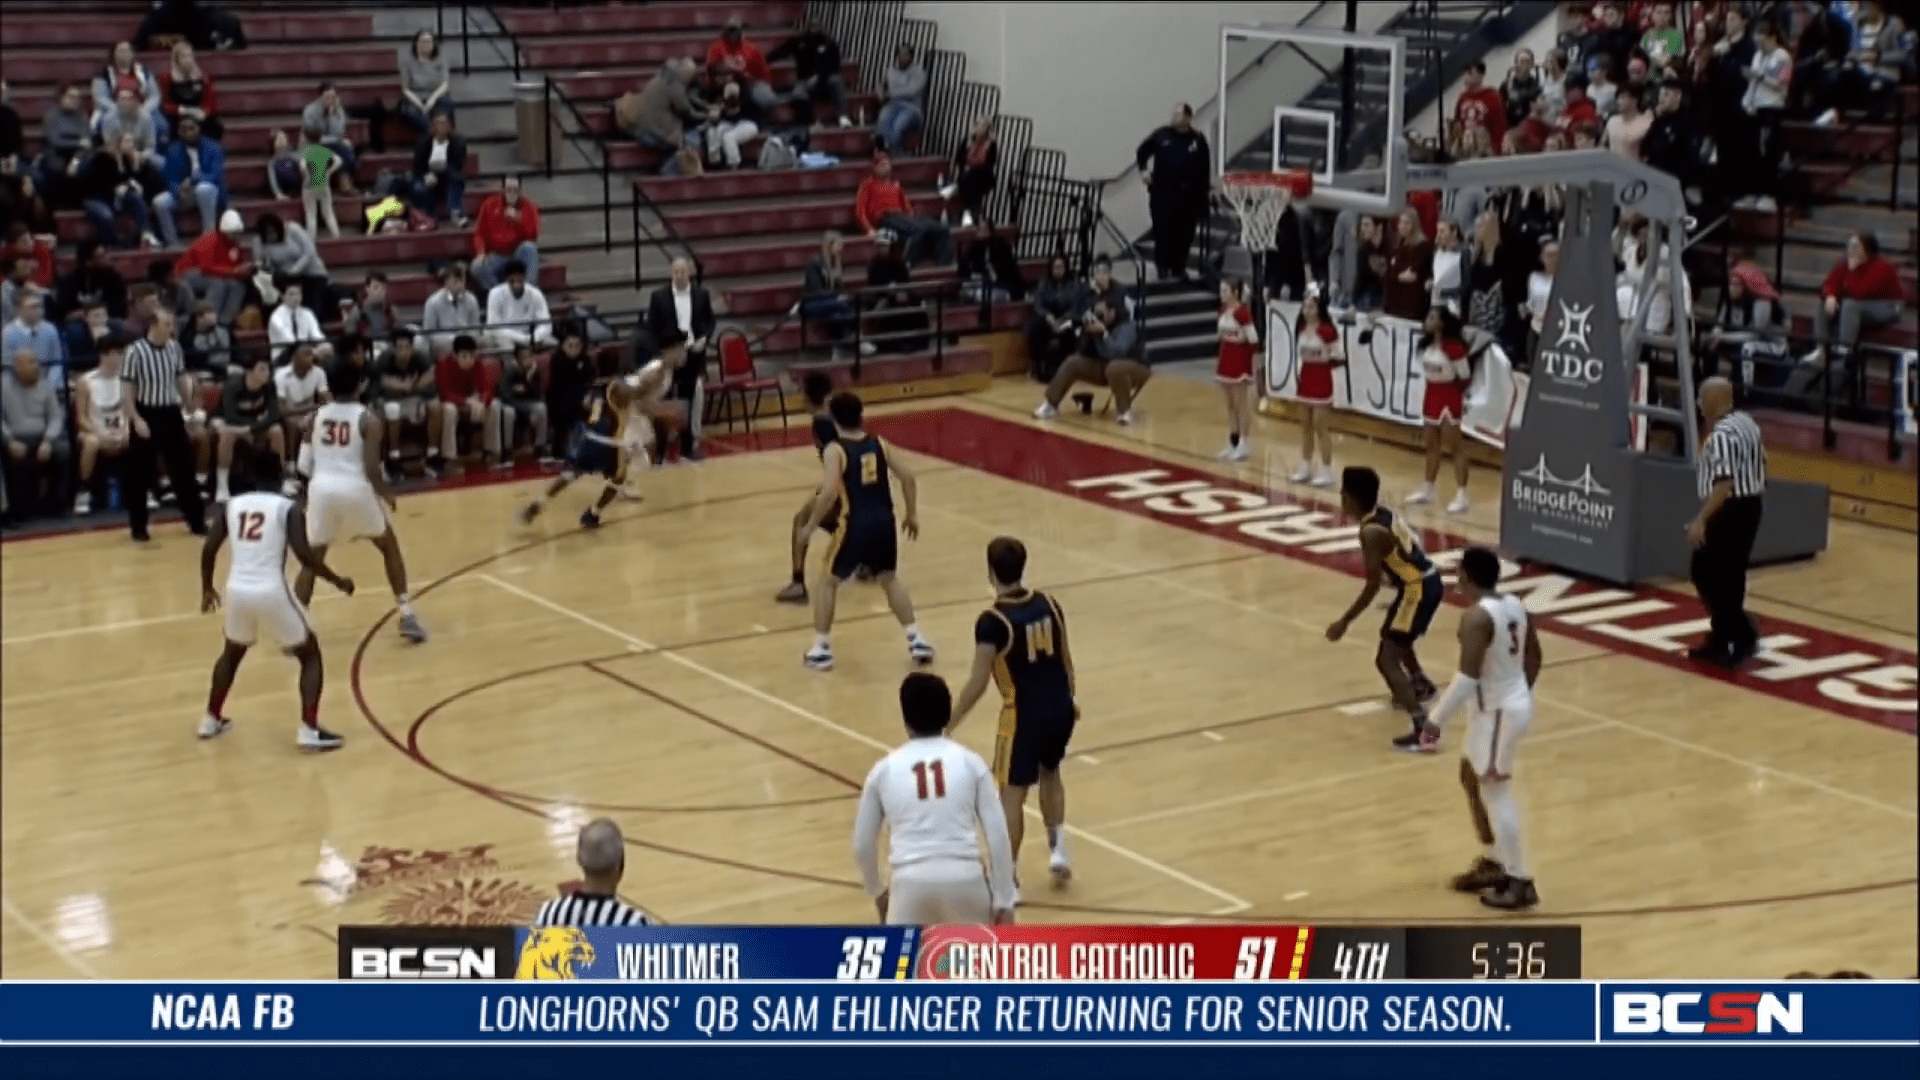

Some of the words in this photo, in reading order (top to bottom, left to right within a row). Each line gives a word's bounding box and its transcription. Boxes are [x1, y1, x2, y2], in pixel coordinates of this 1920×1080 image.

[1541, 351, 1603, 383] TDC
[322, 420, 351, 446] 30
[861, 452, 878, 485] 2
[237, 511, 265, 541] 12
[1025, 617, 1054, 663] 14
[911, 759, 946, 800] 11
